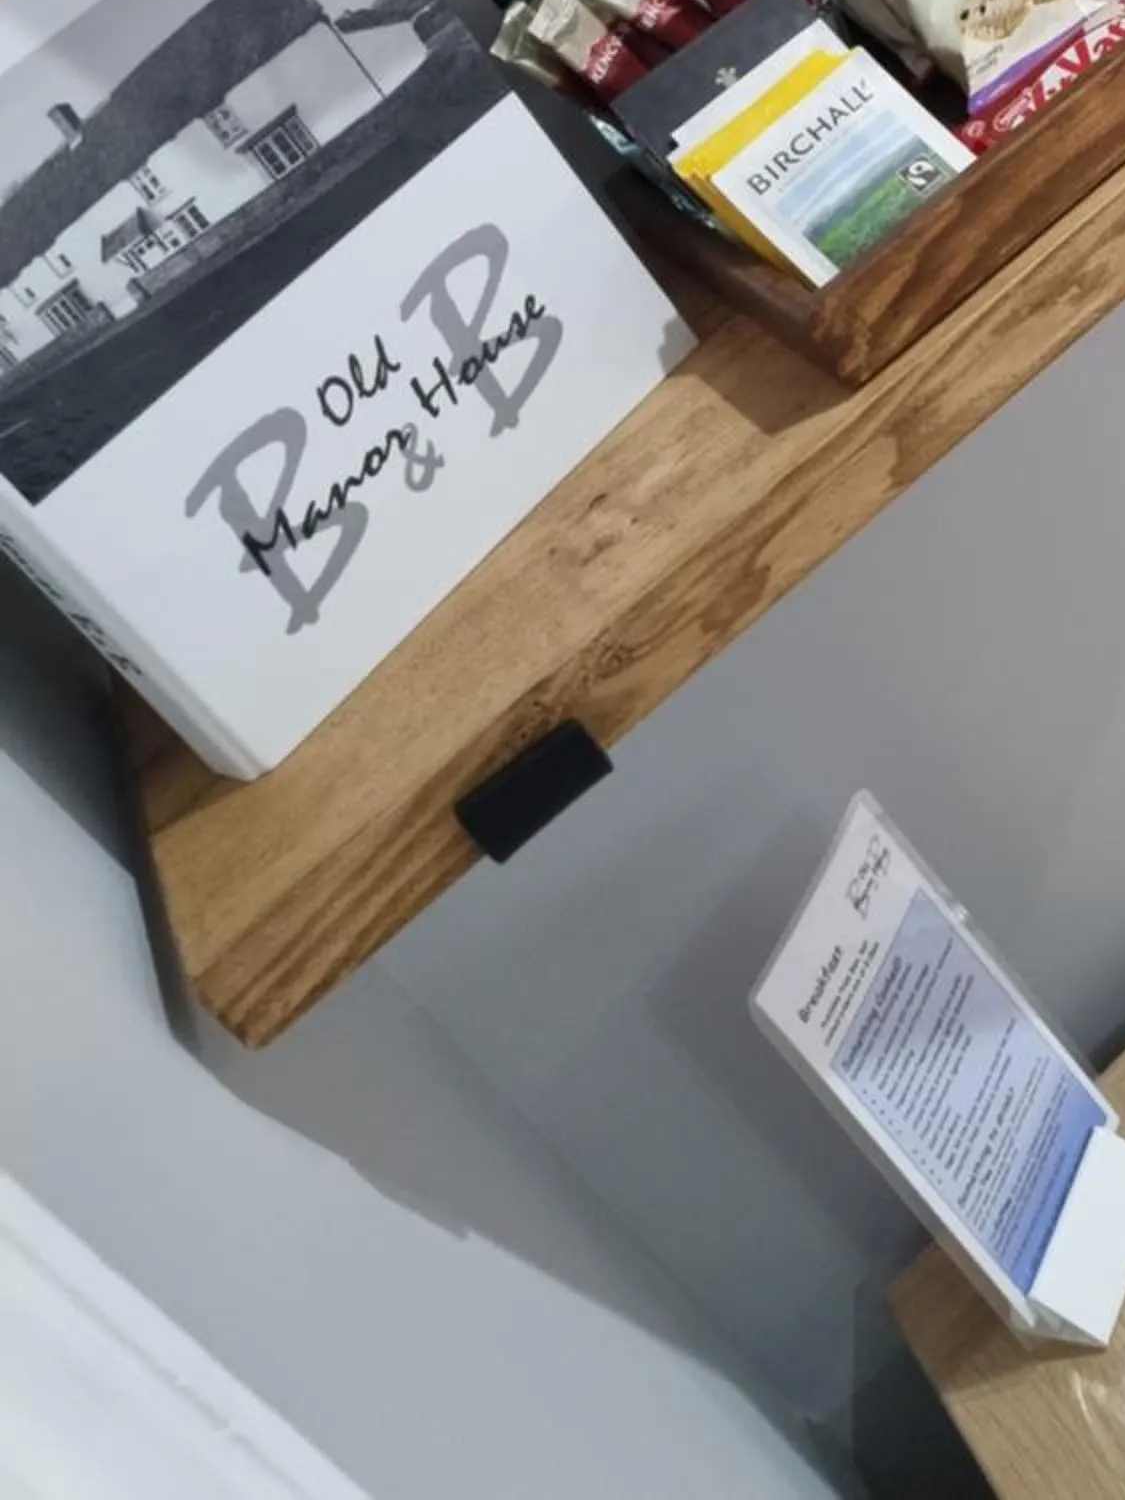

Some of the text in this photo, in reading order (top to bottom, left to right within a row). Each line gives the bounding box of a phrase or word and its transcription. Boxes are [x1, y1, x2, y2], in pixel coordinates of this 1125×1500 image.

[746, 86, 874, 196] BIRCHALL
[315, 334, 401, 426] Old
[241, 294, 546, 576] Manor House
[796, 944, 845, 1024] Breakfast
